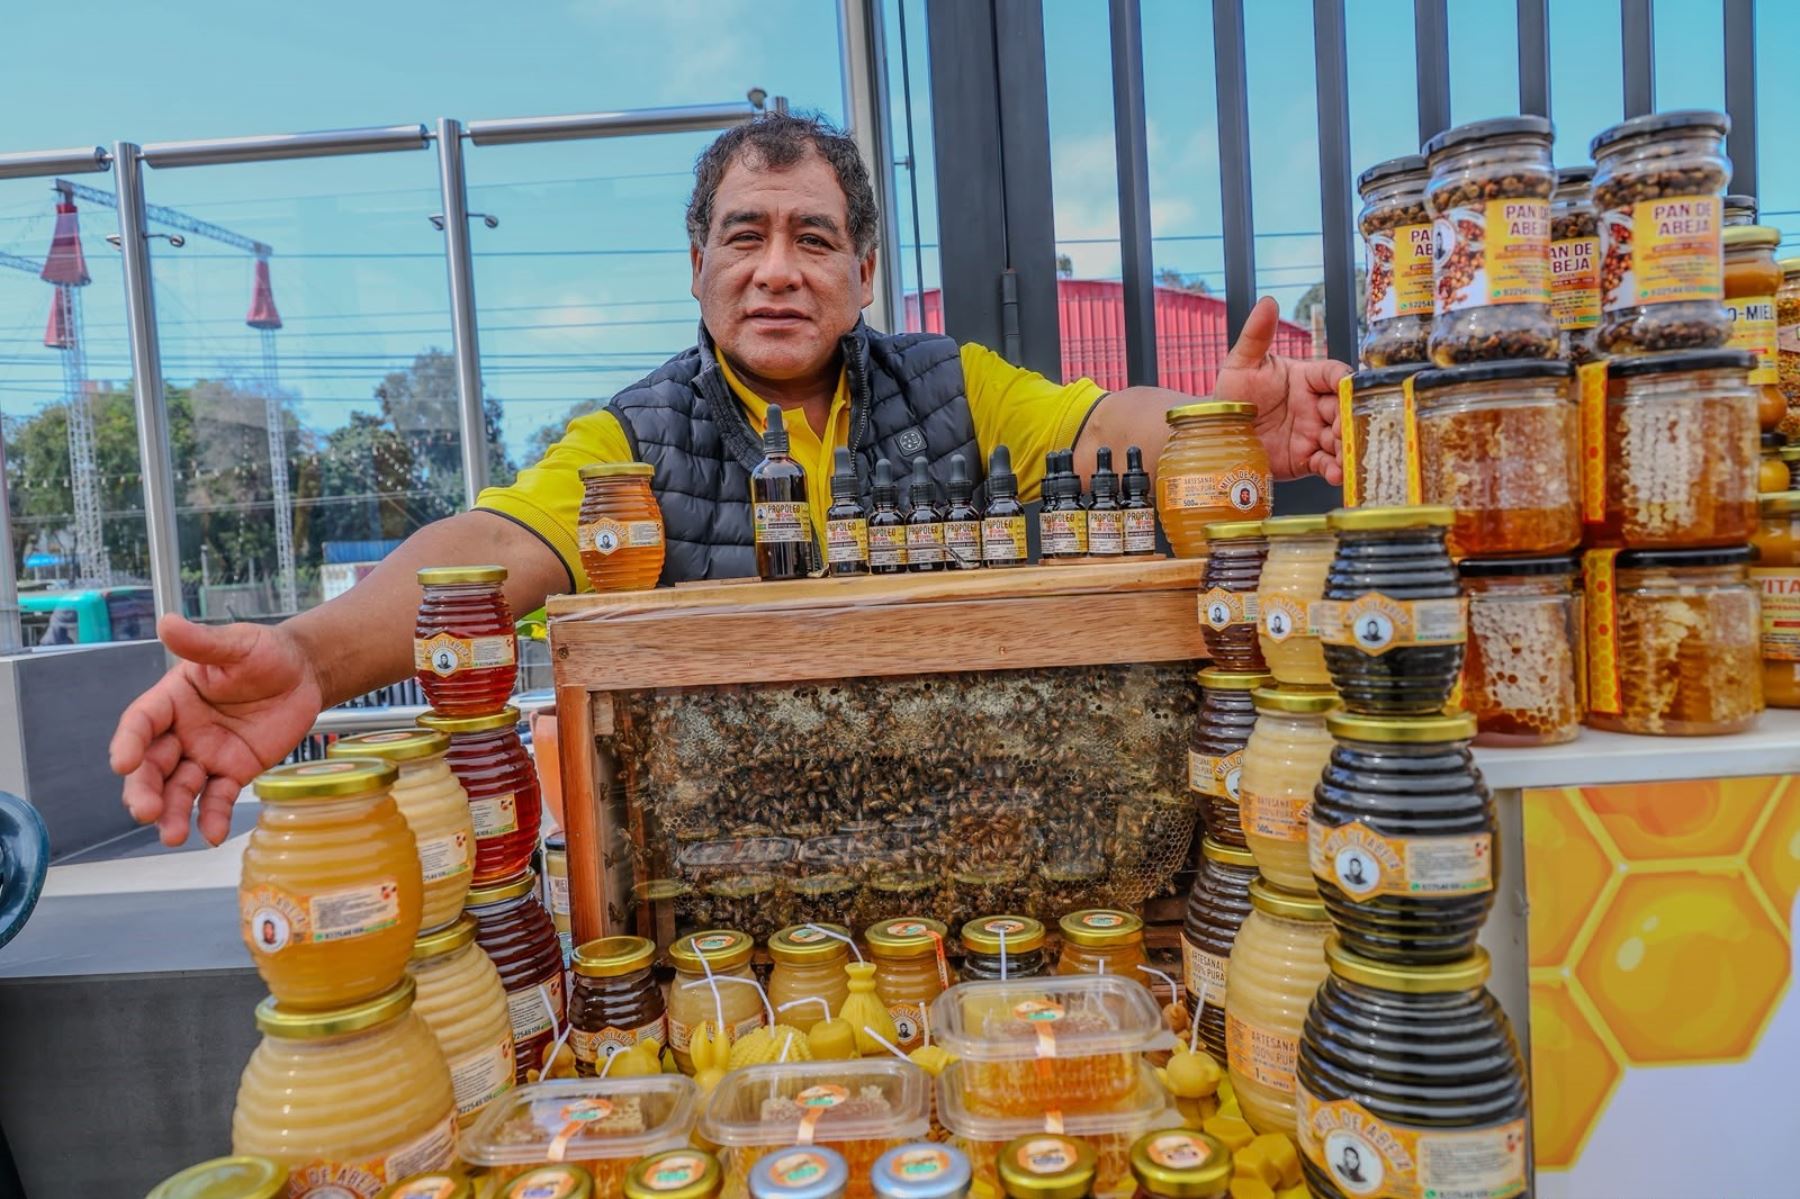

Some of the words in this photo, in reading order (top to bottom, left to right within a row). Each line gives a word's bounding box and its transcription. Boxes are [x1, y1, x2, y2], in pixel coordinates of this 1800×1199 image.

[1506, 206, 1536, 220] PAN
[1655, 204, 1690, 219] PAN
[1696, 202, 1711, 216] DE
[1660, 219, 1709, 235] ABEJA
[1411, 229, 1431, 242] PA
[1574, 243, 1592, 256] DE
[1553, 258, 1590, 273] BEJA
[768, 503, 801, 513] PROPOLEO
[1207, 968, 1225, 982] PURA
[1252, 1031, 1297, 1053] ARTESANA
[1276, 1052, 1295, 1065] PUR
